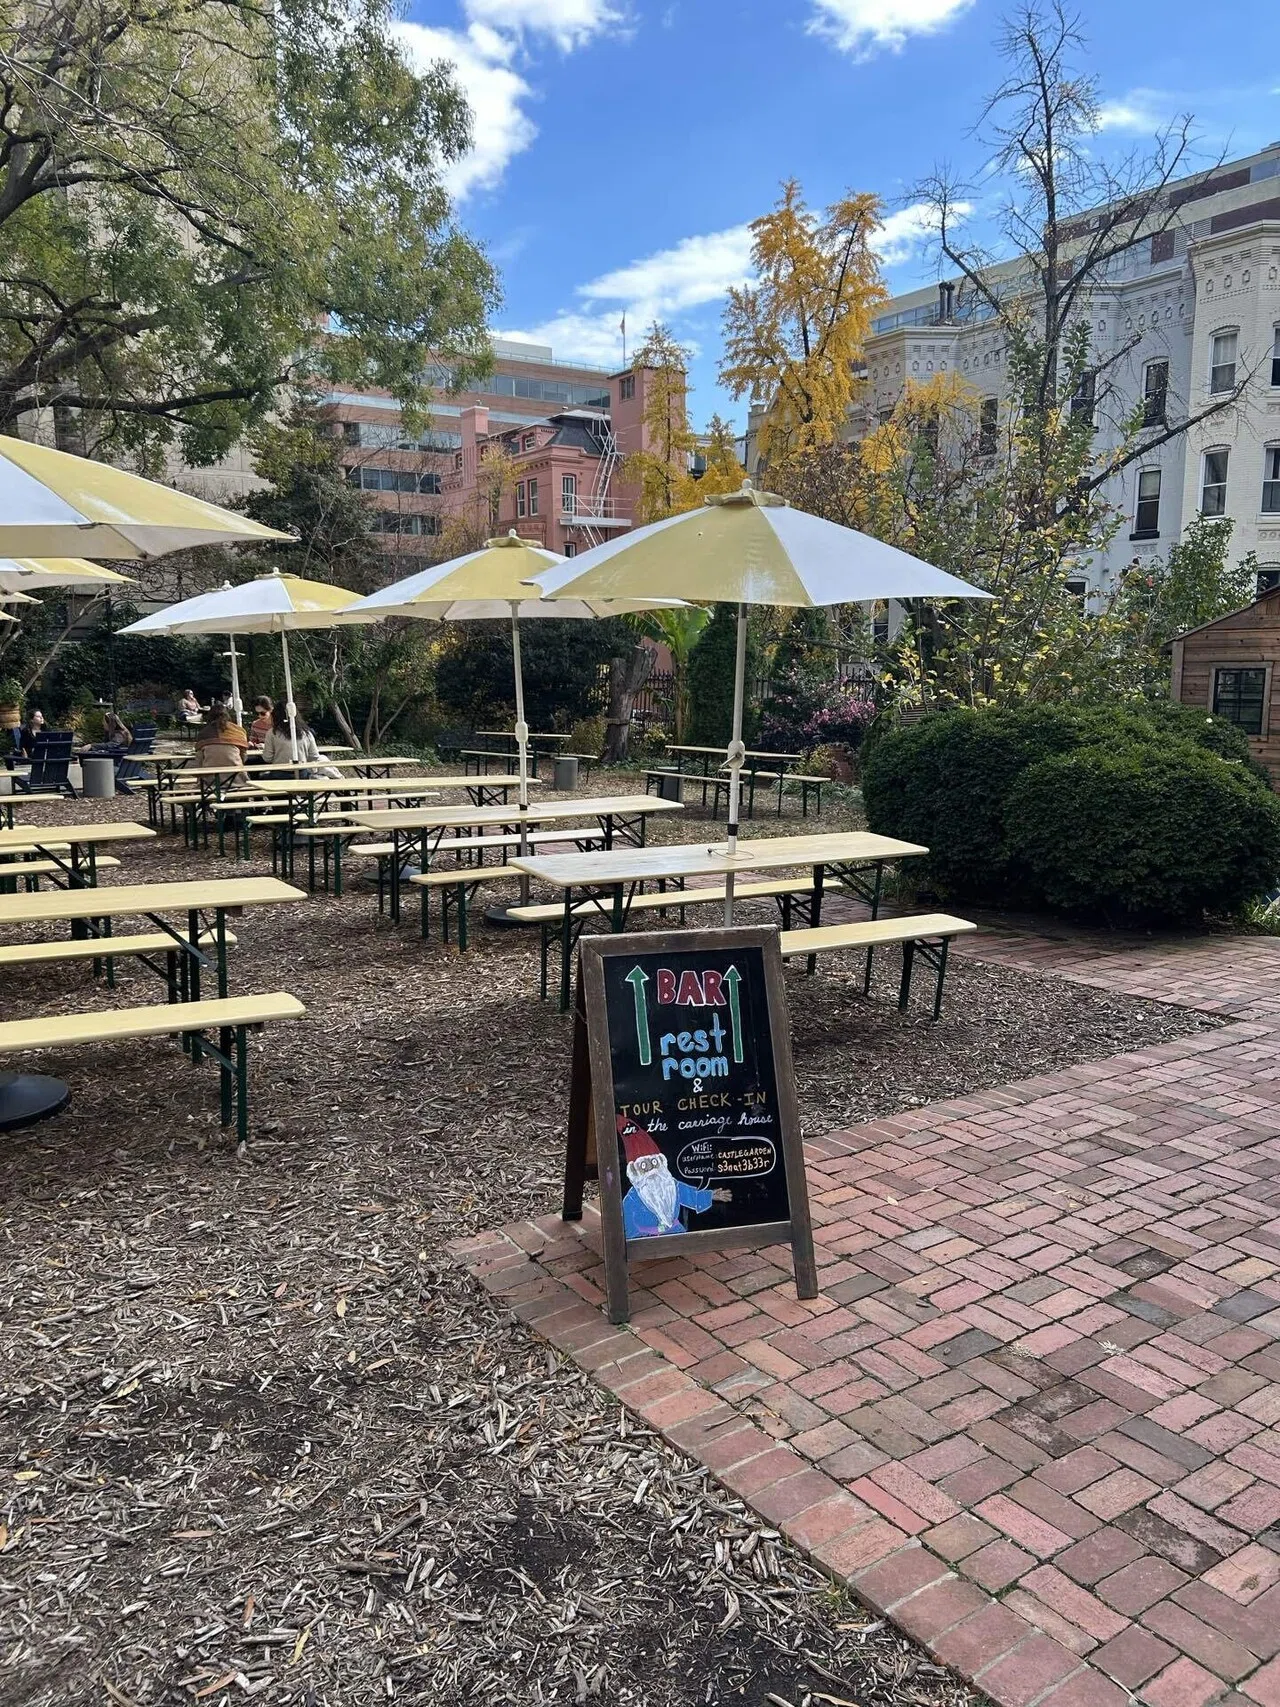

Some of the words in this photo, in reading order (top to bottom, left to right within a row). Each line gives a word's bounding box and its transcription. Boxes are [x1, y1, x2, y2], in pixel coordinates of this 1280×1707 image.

[657, 968, 727, 1006] BAR
[660, 1012, 727, 1056] rest
[661, 1055, 729, 1080] room
[692, 1078, 704, 1093] &
[620, 1101, 663, 1118] TOUR
[623, 1122, 637, 1134] in
[647, 1117, 668, 1132] the
[678, 1114, 732, 1134] carriage
[738, 1112, 773, 1126] house
[718, 1147, 772, 1159] CASTLEGARDEN
